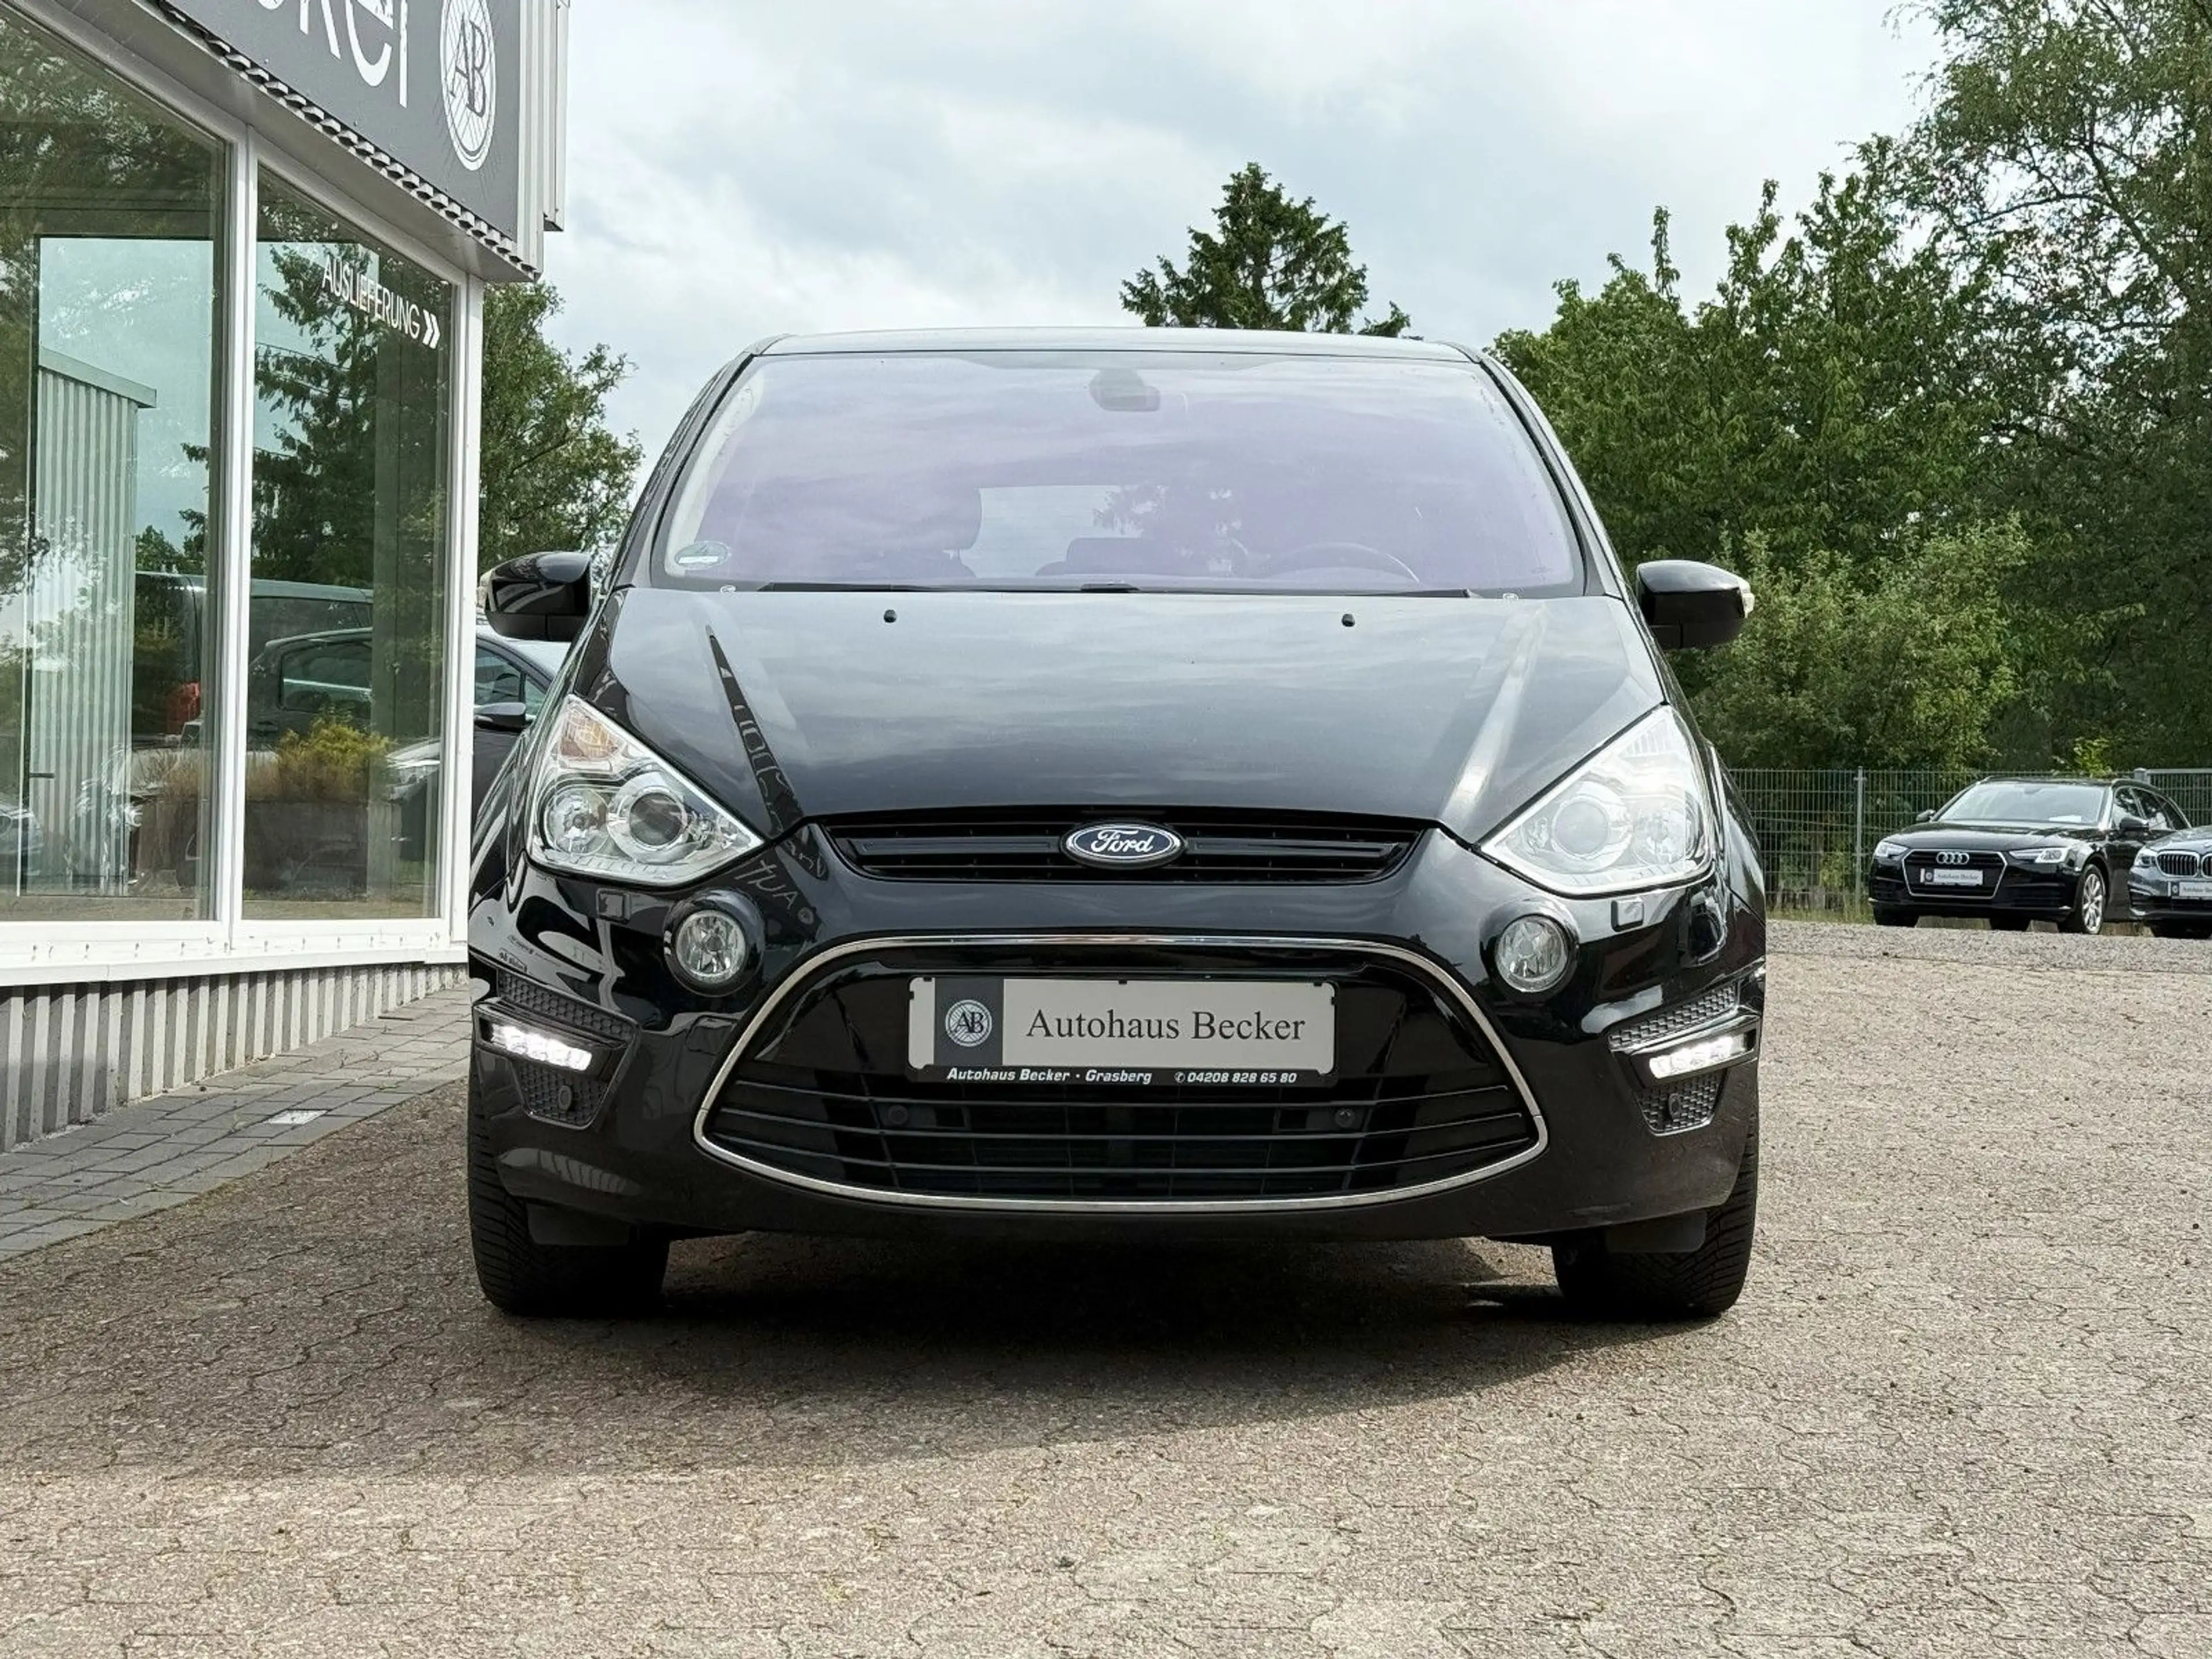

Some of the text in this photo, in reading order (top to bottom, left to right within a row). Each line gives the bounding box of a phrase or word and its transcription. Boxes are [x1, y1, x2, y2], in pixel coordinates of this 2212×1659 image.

[321, 253, 421, 340] AUSLIEFERUNG
[1090, 829, 1154, 853] Ford
[1026, 1009, 1306, 1040] Autohaus Becker
[946, 1067, 1298, 1085] Autohaus Becker Grasberg 04208 828 65 80
